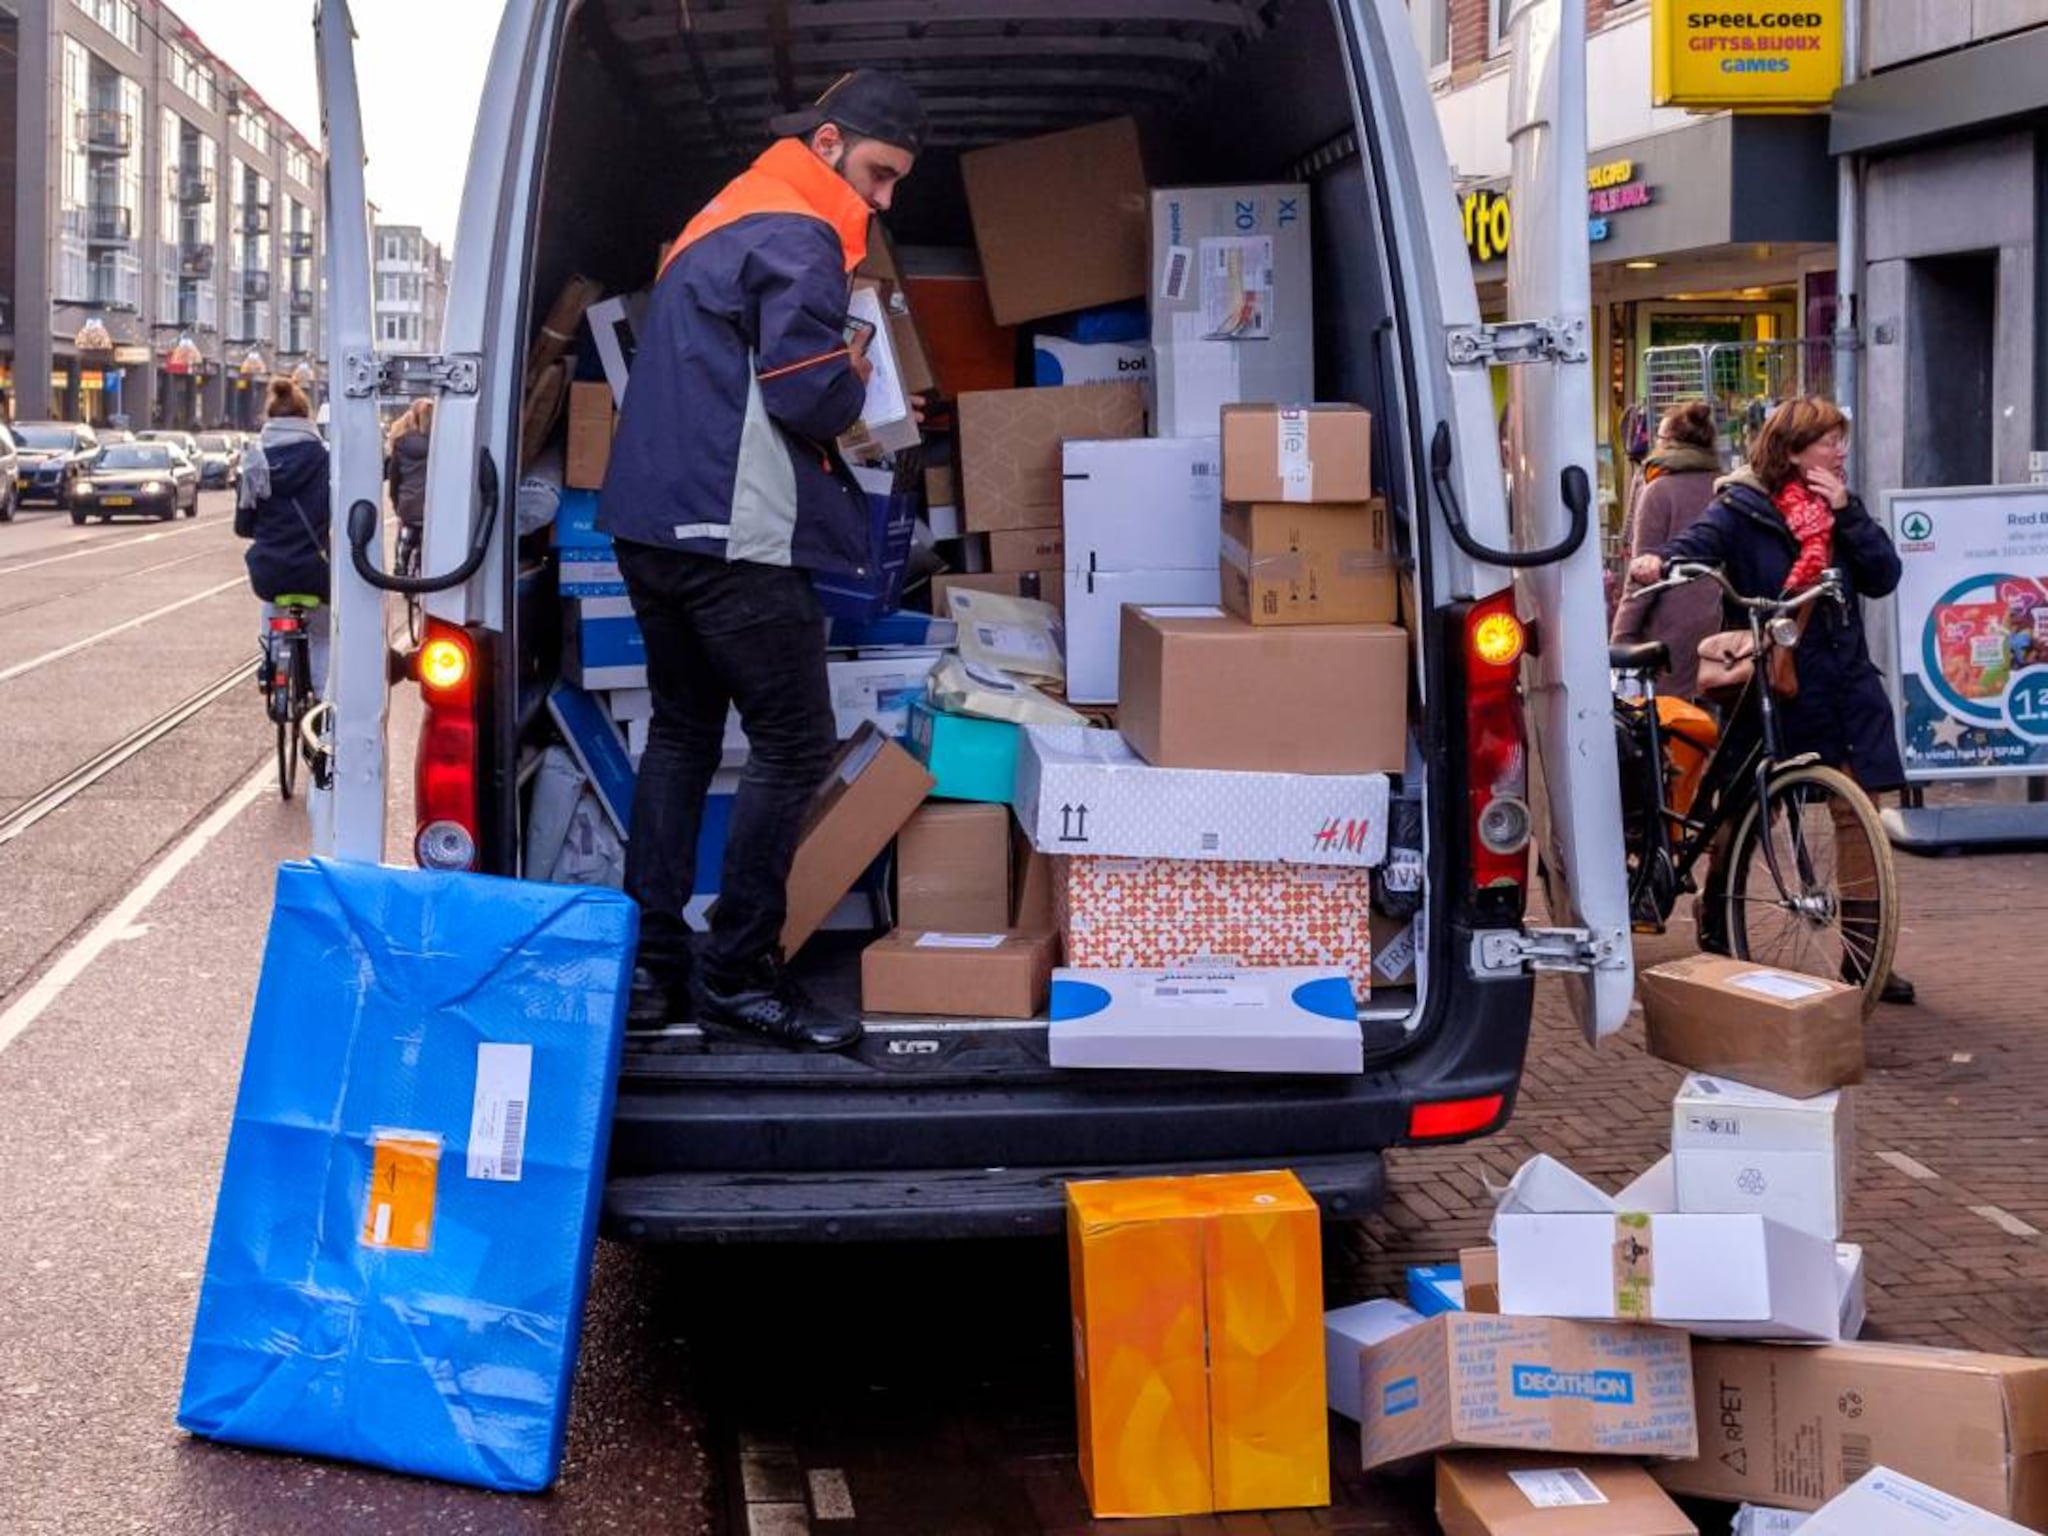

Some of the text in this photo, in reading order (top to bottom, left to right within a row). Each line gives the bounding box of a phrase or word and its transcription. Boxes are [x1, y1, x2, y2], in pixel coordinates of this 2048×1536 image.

[1278, 198, 1297, 229] XL
[1462, 189, 1511, 261] rto
[1117, 356, 1147, 371] bol
[2008, 514, 2036, 525] Red
[1312, 816, 1369, 854] H&M
[1520, 1372, 1627, 1397] DECATHLON
